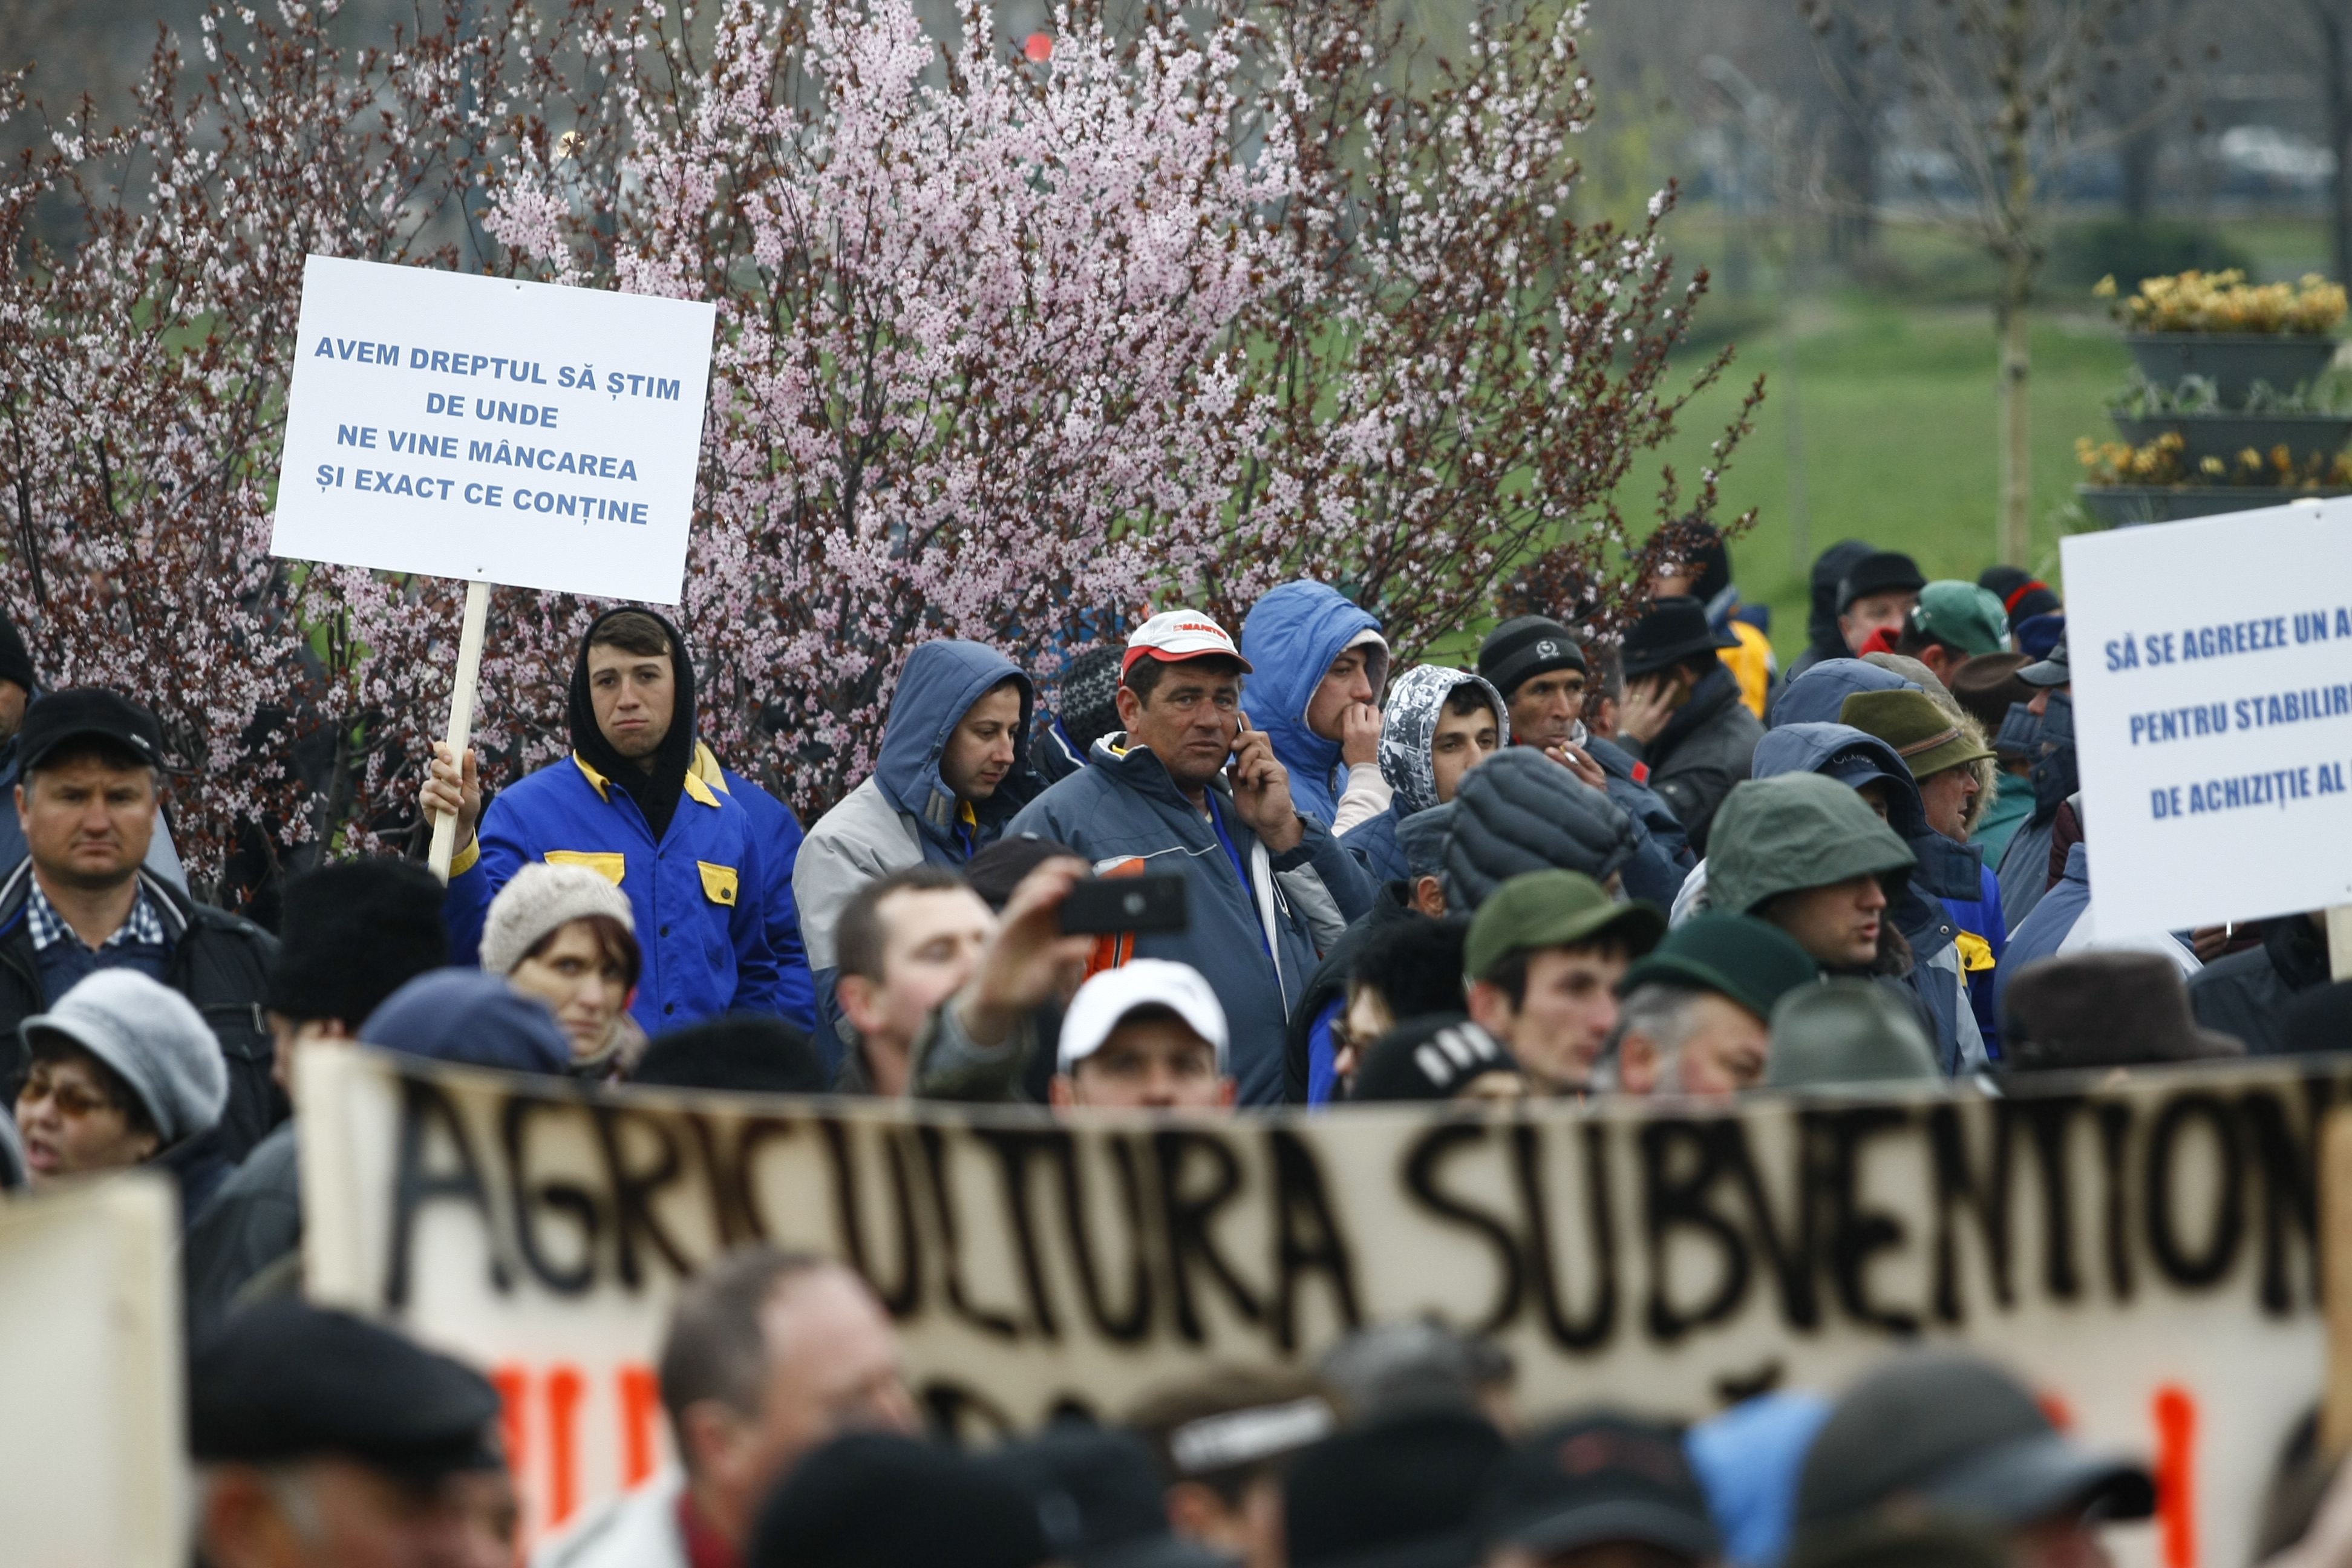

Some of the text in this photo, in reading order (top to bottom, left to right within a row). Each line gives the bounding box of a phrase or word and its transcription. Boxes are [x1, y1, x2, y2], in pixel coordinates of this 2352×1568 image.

[315, 336, 681, 401] AVEM DREPTUL SĂ ȘTIM
[426, 393, 559, 428] DE UNDE
[337, 424, 638, 482] NE VINE MÂNCAREA
[315, 464, 649, 526] ȘI EXACT CE CONȚINE
[2105, 607, 2352, 671] SĂ SE AGREEZE UN A
[2129, 684, 2352, 745] PENTRU STABILIR
[2151, 786, 2184, 820] DE
[2190, 766, 2310, 812] ACHIZIȚIE
[2318, 761, 2347, 795] AL
[386, 1076, 1364, 1356] AGRICULTURA
